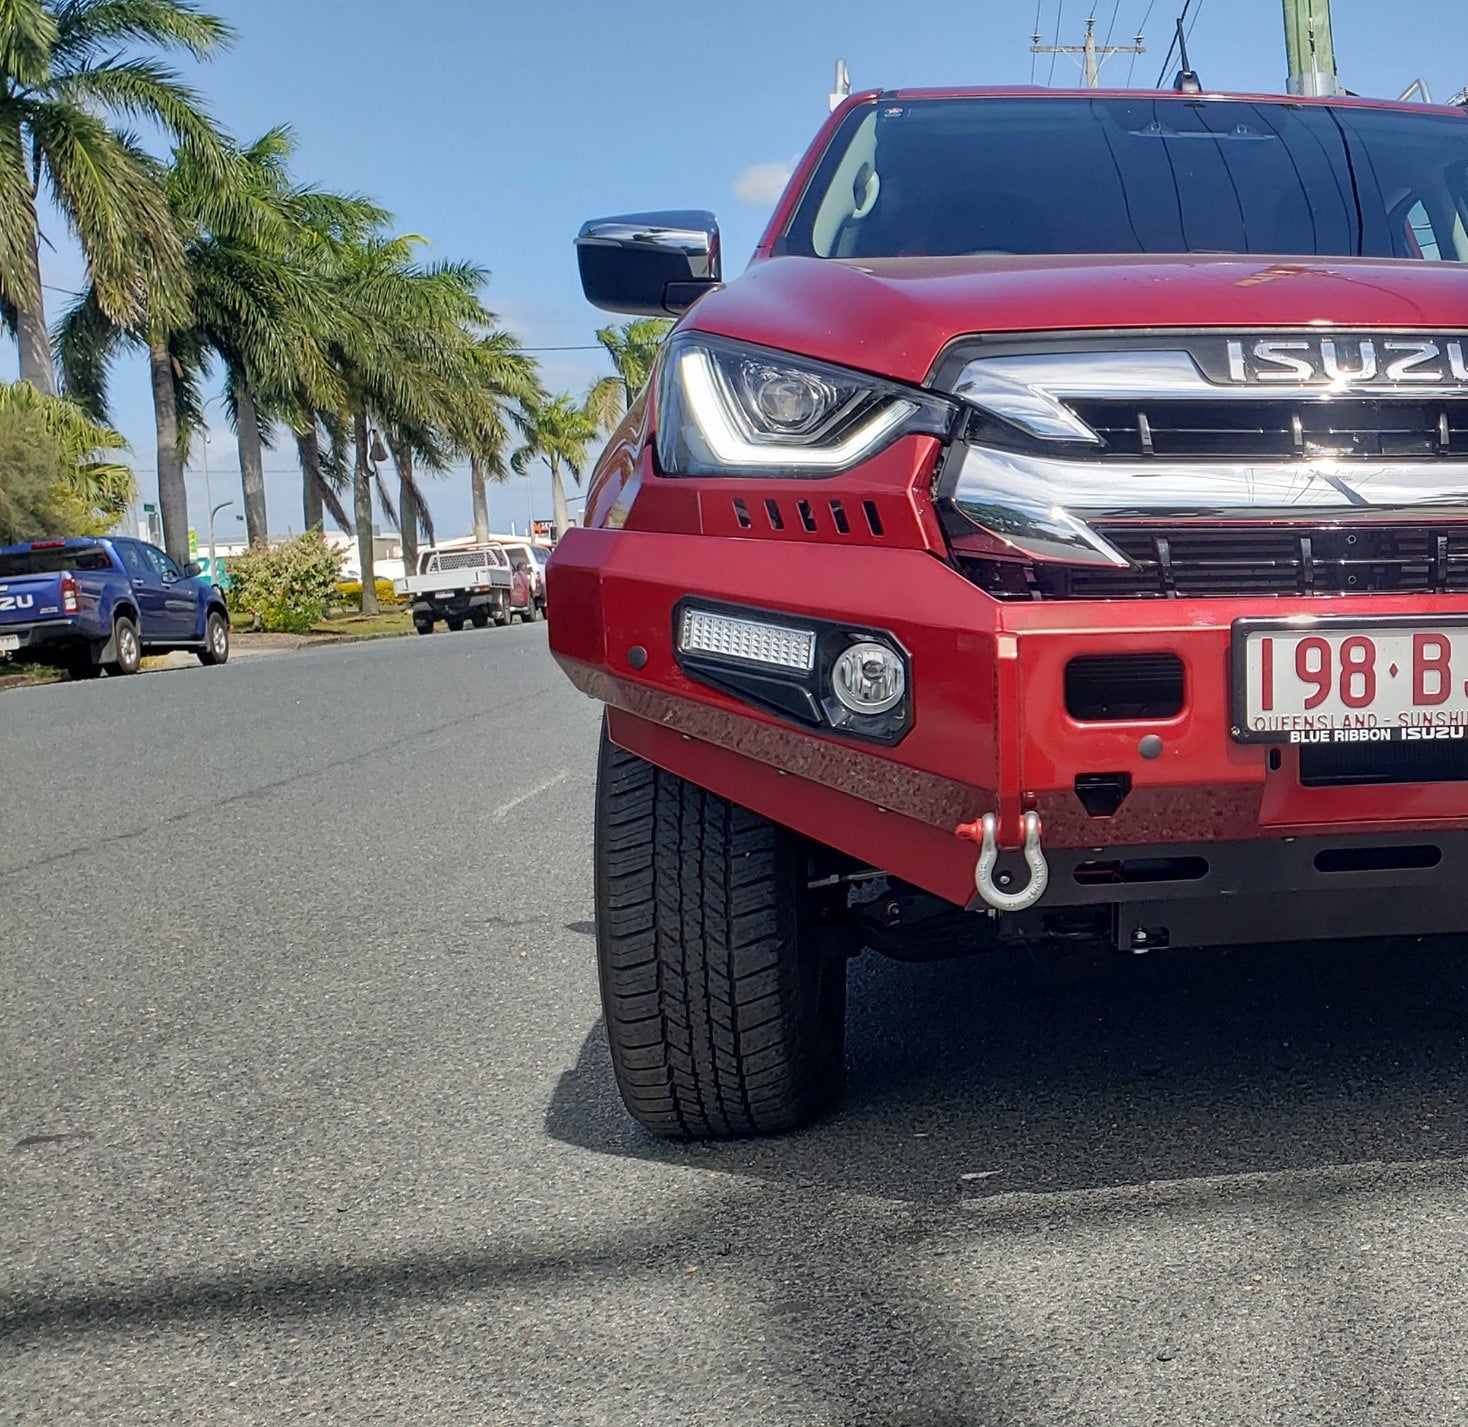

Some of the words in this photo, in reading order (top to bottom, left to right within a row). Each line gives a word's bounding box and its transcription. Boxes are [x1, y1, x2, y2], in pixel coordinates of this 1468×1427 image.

[1254, 711, 1378, 731] QUEENSLAND
[1290, 730, 1331, 743] BLUE
[1334, 728, 1391, 742] RIBBON
[1401, 725, 1464, 740] ISUZU
